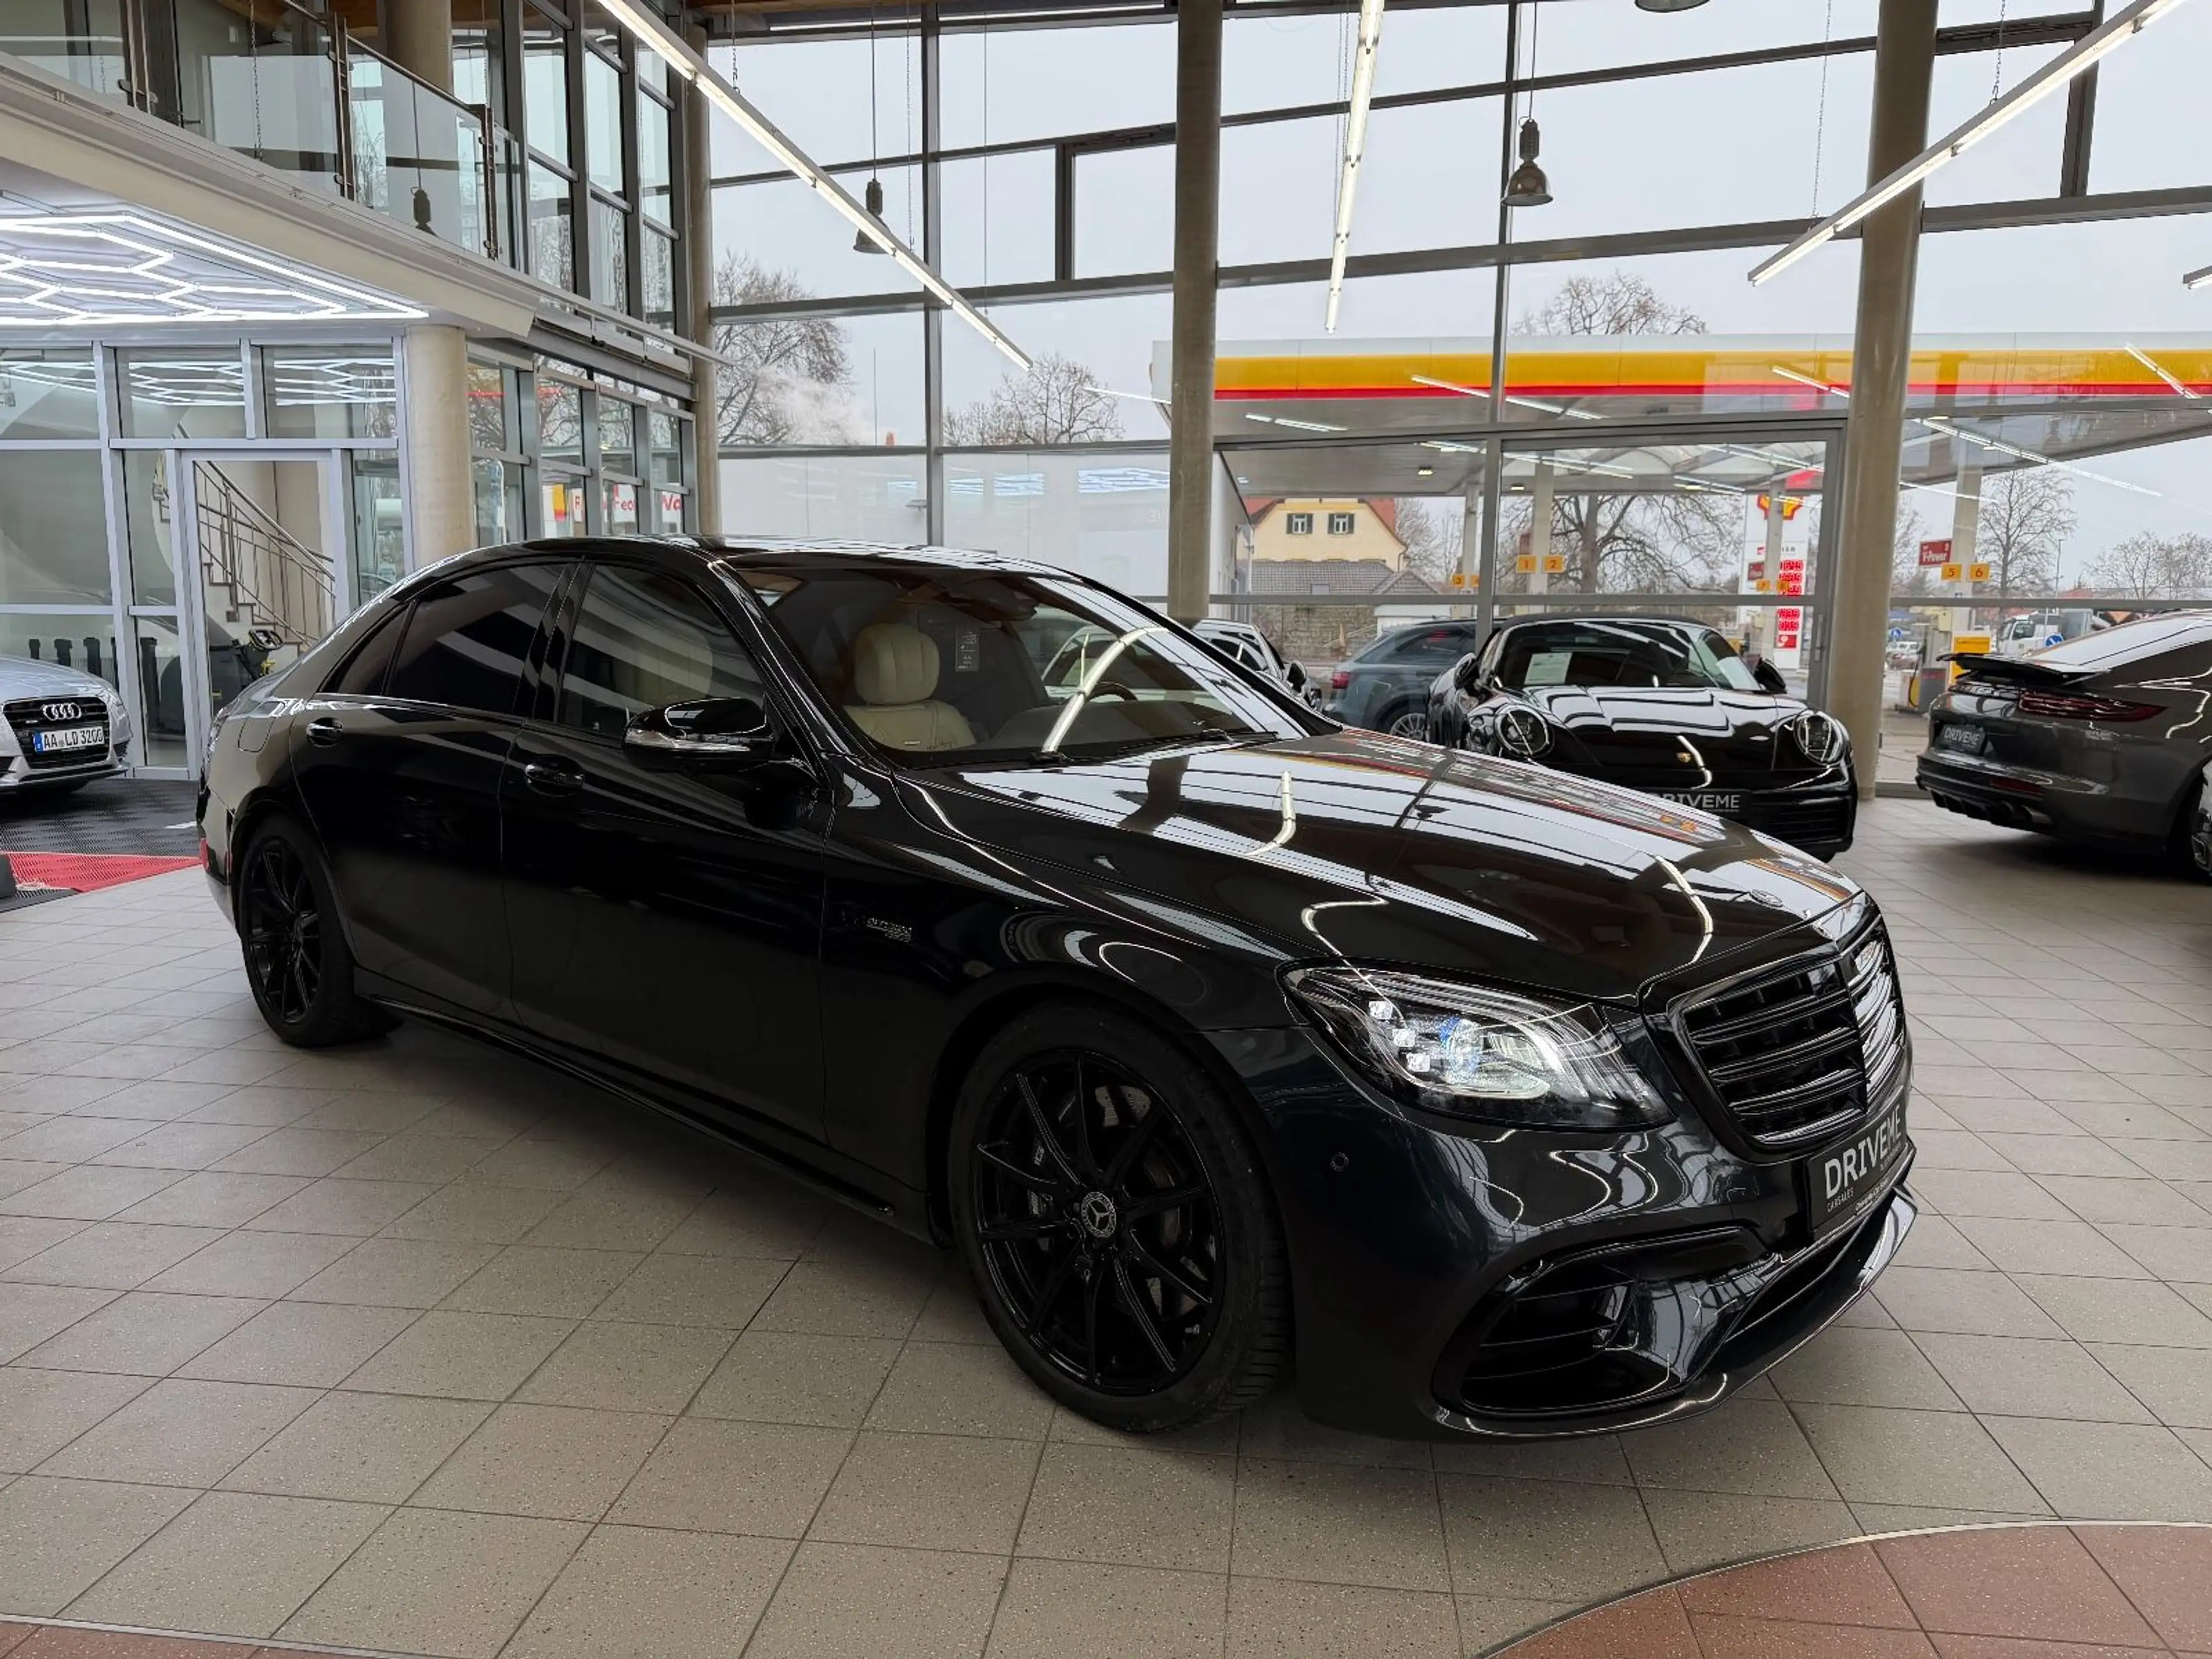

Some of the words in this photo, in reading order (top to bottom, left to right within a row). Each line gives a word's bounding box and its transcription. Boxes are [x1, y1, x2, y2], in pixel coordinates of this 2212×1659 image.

[1948, 567, 1956, 577] 5
[1975, 567, 1983, 577] 6
[44, 734, 58, 749] AA
[1651, 793, 1740, 809] RIVEME
[1825, 1104, 1901, 1199] DRIVEME
